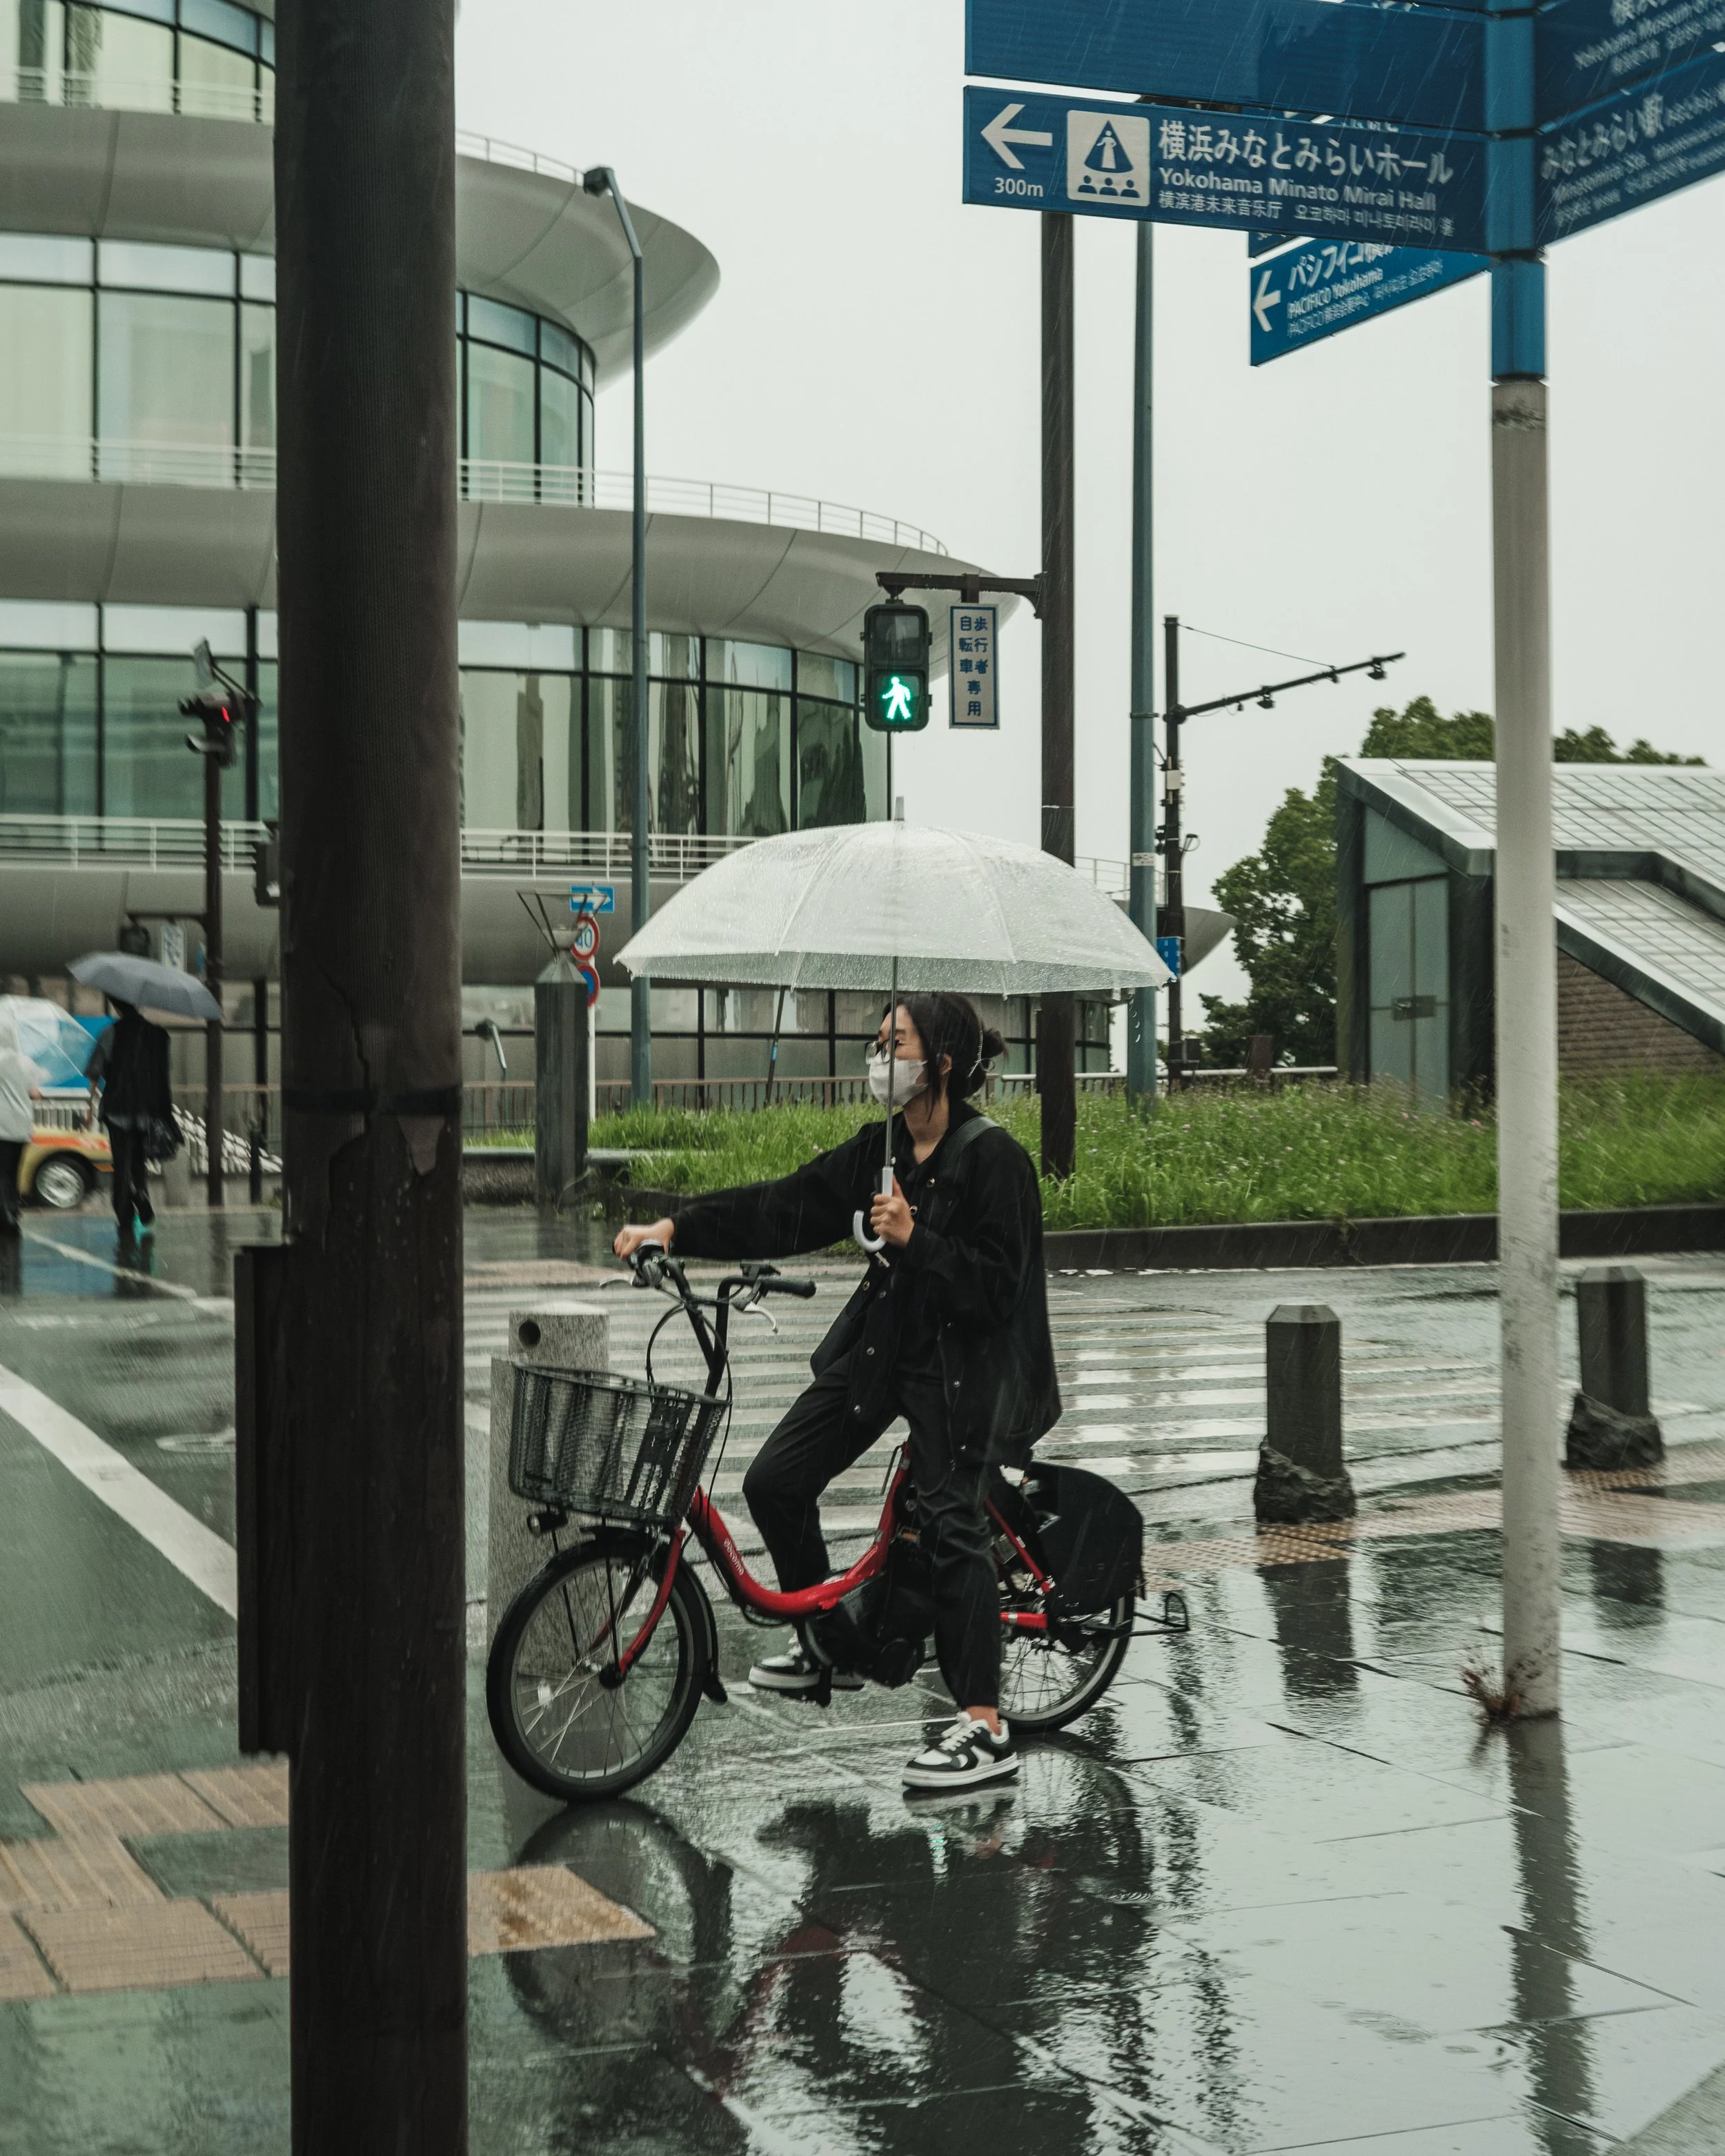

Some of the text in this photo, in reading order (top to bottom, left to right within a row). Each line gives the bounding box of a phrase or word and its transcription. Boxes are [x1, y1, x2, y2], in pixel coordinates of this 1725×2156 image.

[1159, 119, 1454, 184] 横浜みなとみらいホール
[994, 177, 1044, 197] 300m
[1159, 167, 1436, 211] Yokohama Minato Mirai Hall
[1159, 190, 1283, 219] 横滨港未来音乐厅
